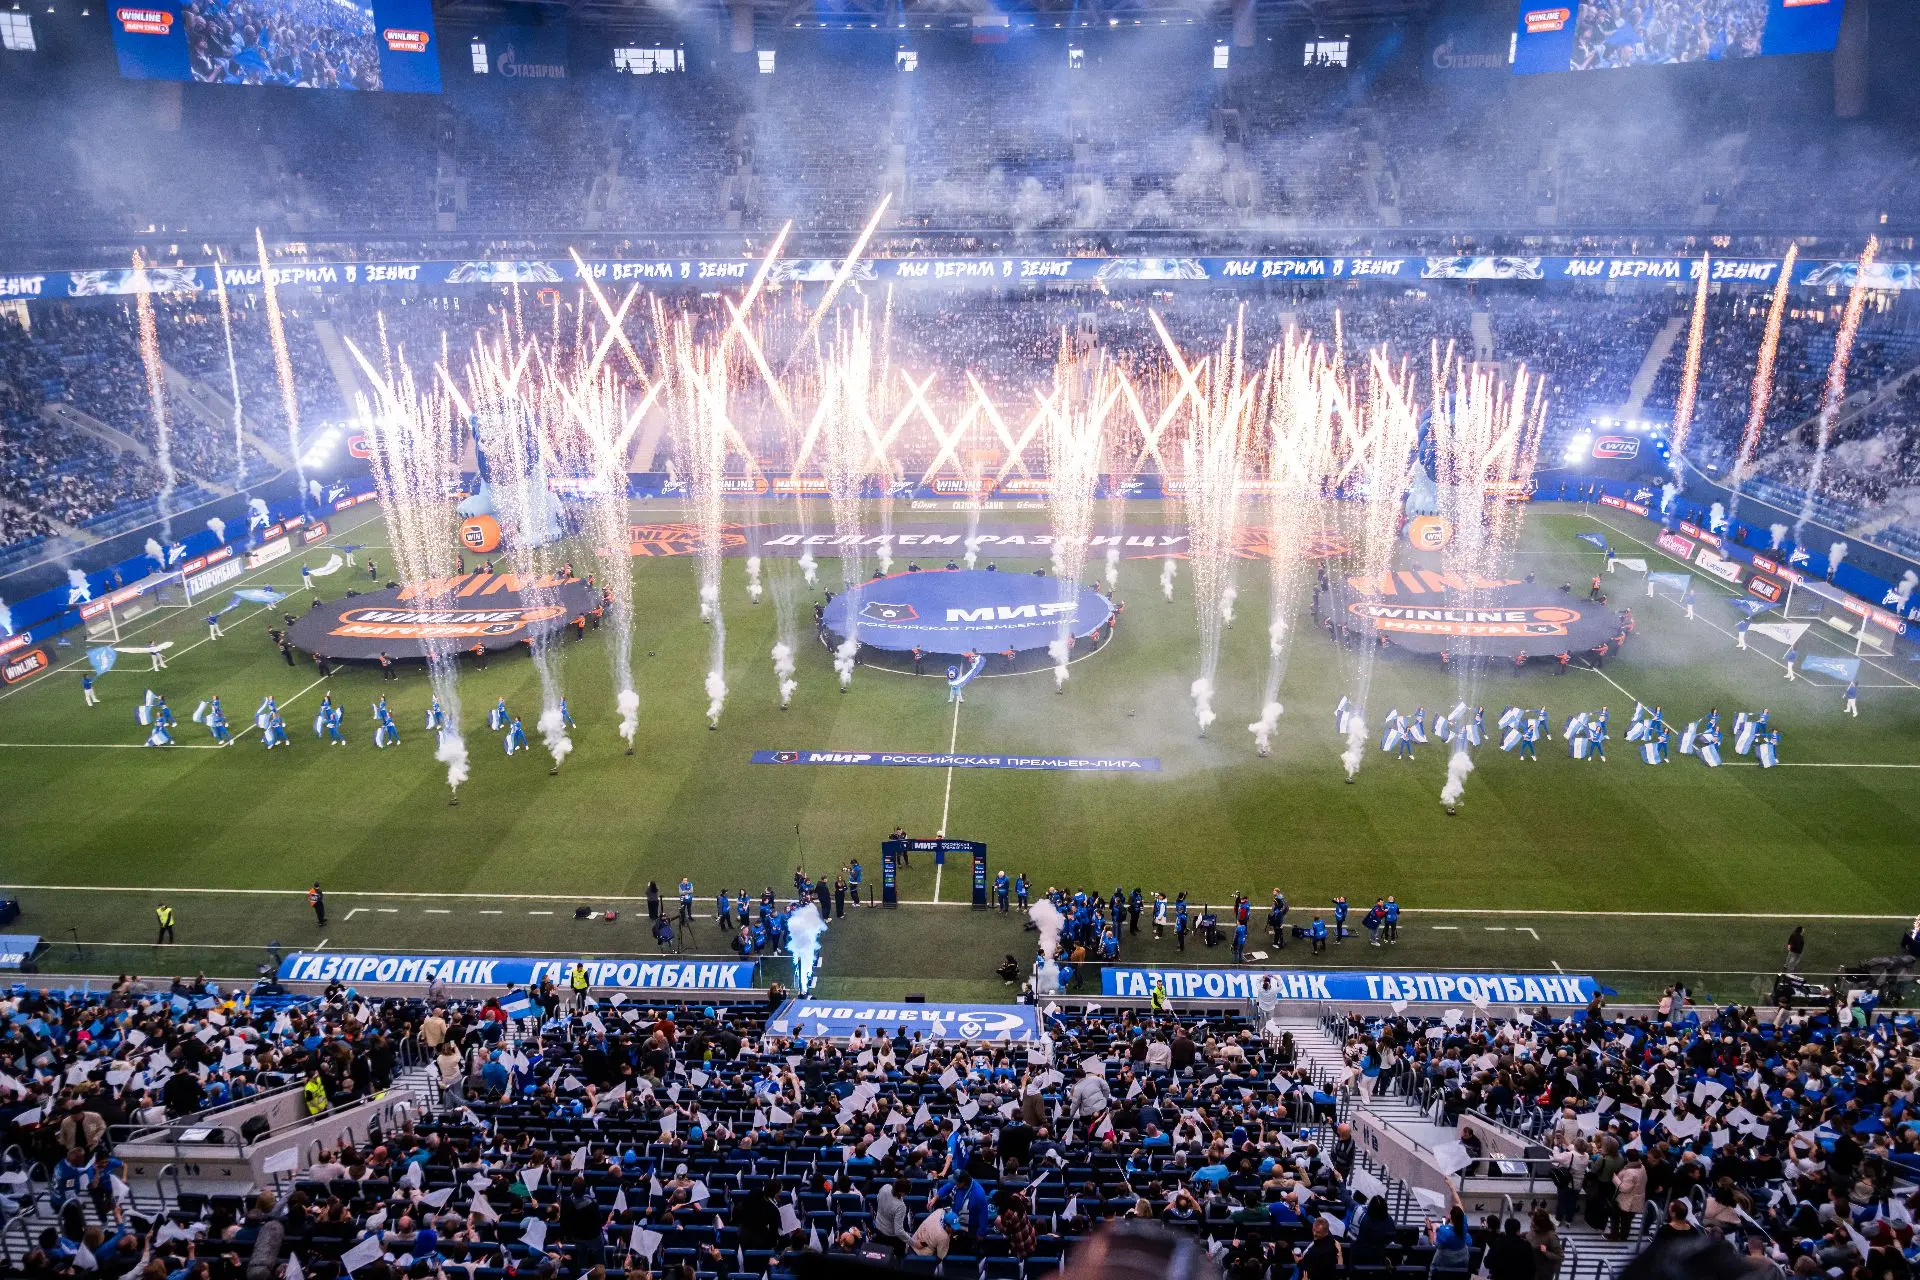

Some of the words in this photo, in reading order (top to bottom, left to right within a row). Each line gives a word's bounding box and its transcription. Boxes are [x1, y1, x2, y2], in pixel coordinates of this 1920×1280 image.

[121, 11, 161, 22] WINLINE
[1529, 12, 1560, 21] WINLINE
[387, 32, 420, 42] WINLINE
[226, 269, 261, 286] МЫ
[344, 266, 357, 282] В
[365, 265, 421, 282] ЗЕНИТ
[612, 262, 673, 281] ВЕРИМ
[680, 261, 692, 278] В
[698, 262, 749, 278] ЗЕНИТ
[896, 262, 930, 278] МЫ
[934, 262, 995, 279] ВЕРИМ
[1002, 261, 1013, 277] В
[1021, 261, 1073, 277] ЗЕНИТ
[1223, 260, 1257, 276] МЫ
[1262, 259, 1325, 278] ВЕРИМ
[1333, 259, 1345, 276] В
[1351, 258, 1405, 275] ЗЕНИТ
[1564, 260, 1604, 276] МЫ
[1609, 260, 1680, 279] ВЕРИМ
[1712, 261, 1778, 280] ЗЕНИТ
[0, 276, 46, 295] ЕНИТ
[1606, 442, 1635, 452] WIN
[717, 480, 755, 492] INLINE
[936, 480, 982, 492] WINLINE
[952, 501, 1004, 510] ГАЗПРОБАНК
[466, 532, 482, 542] WIN
[763, 534, 961, 546] ДЕЛАЕМ
[1426, 532, 1443, 541] WIN
[1751, 579, 1776, 598] WINLINE
[357, 610, 521, 624] WINLINE
[946, 601, 1079, 622] МИР
[1369, 605, 1527, 622] WINLINE
[1384, 621, 1456, 632] МАТЧ
[1459, 623, 1522, 634] ТУРА
[5, 656, 39, 680] WINLINE
[809, 753, 872, 763] МИР
[881, 754, 1001, 765] РОССИЙСКАЯ
[1007, 758, 1142, 768] ПРЕМЬЕР-ЛИГА
[914, 841, 938, 850] МИР
[289, 956, 499, 984] ГАЗПРОМБАНК
[1365, 975, 1588, 1003] ГАЗПРОМБАНК
[798, 1006, 956, 1023] ГАЗПРОМ
